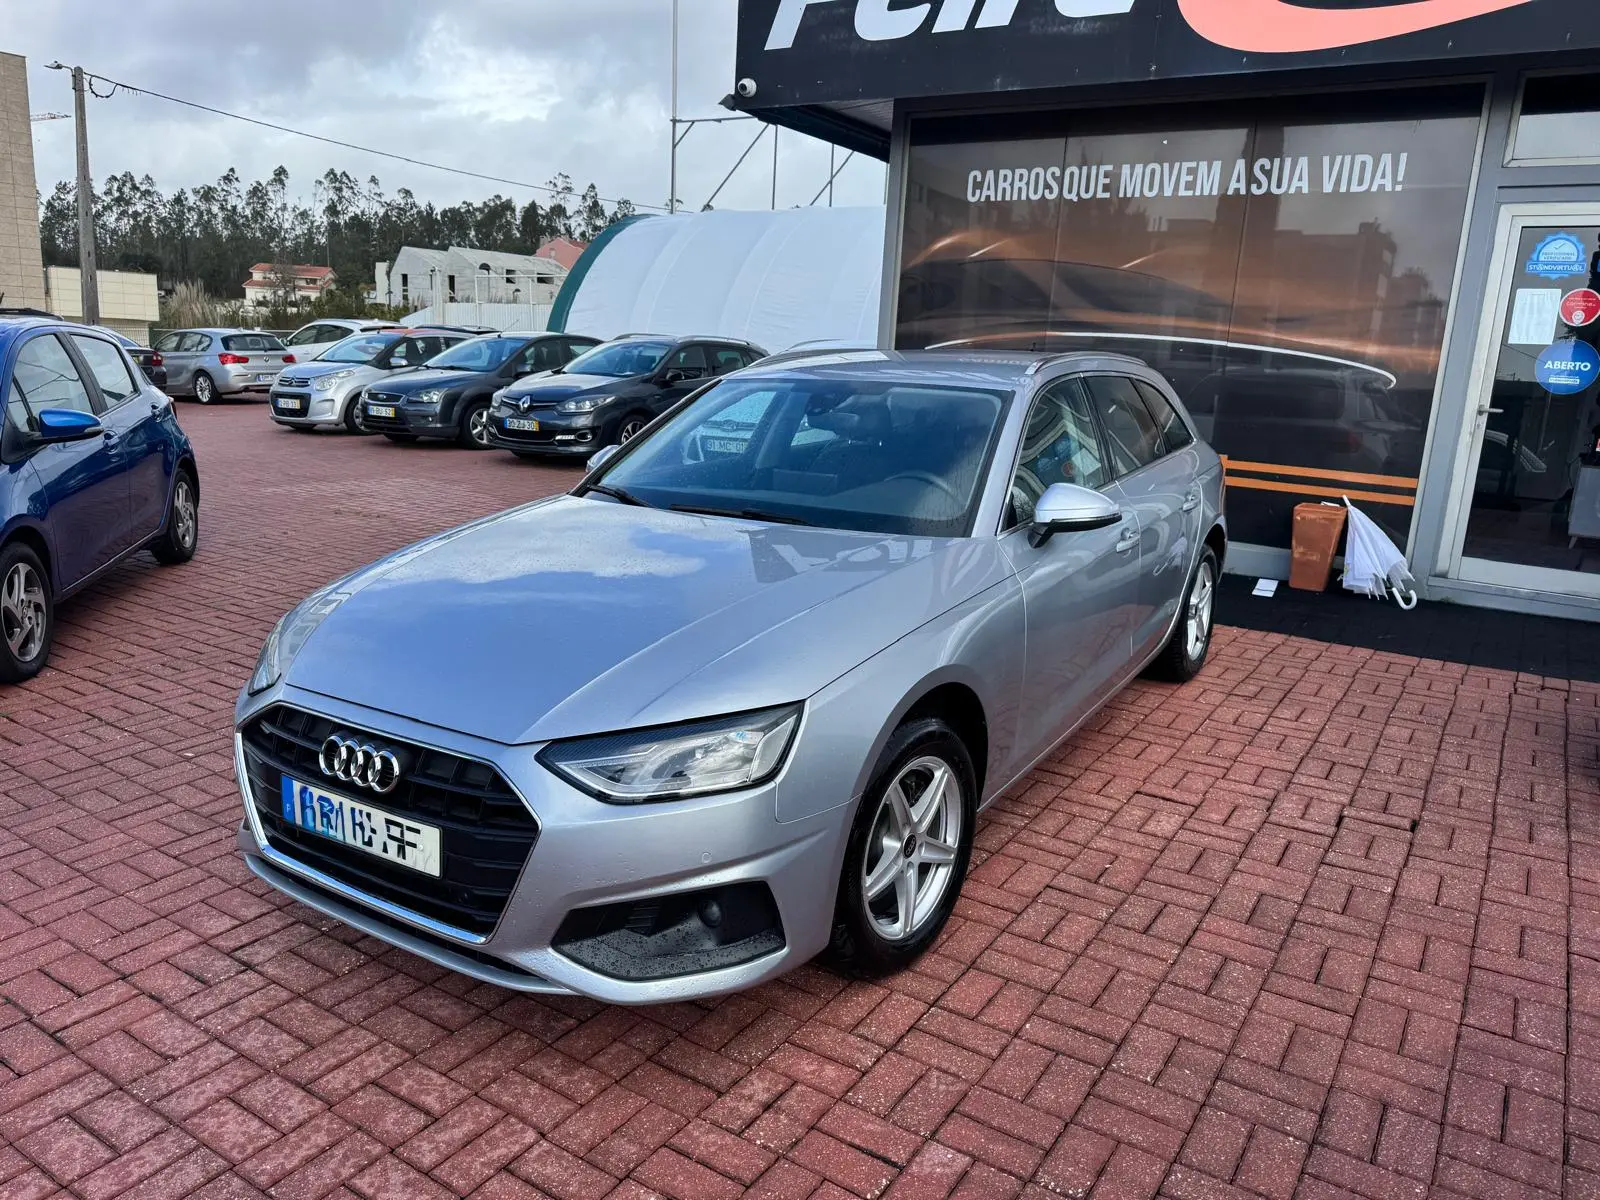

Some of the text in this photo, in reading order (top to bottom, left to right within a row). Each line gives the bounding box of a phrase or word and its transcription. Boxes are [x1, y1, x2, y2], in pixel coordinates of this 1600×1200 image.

[966, 152, 1408, 203] CARROS QUE MOVEM A SUA VIDA!
[1543, 359, 1592, 371] ABERTO
